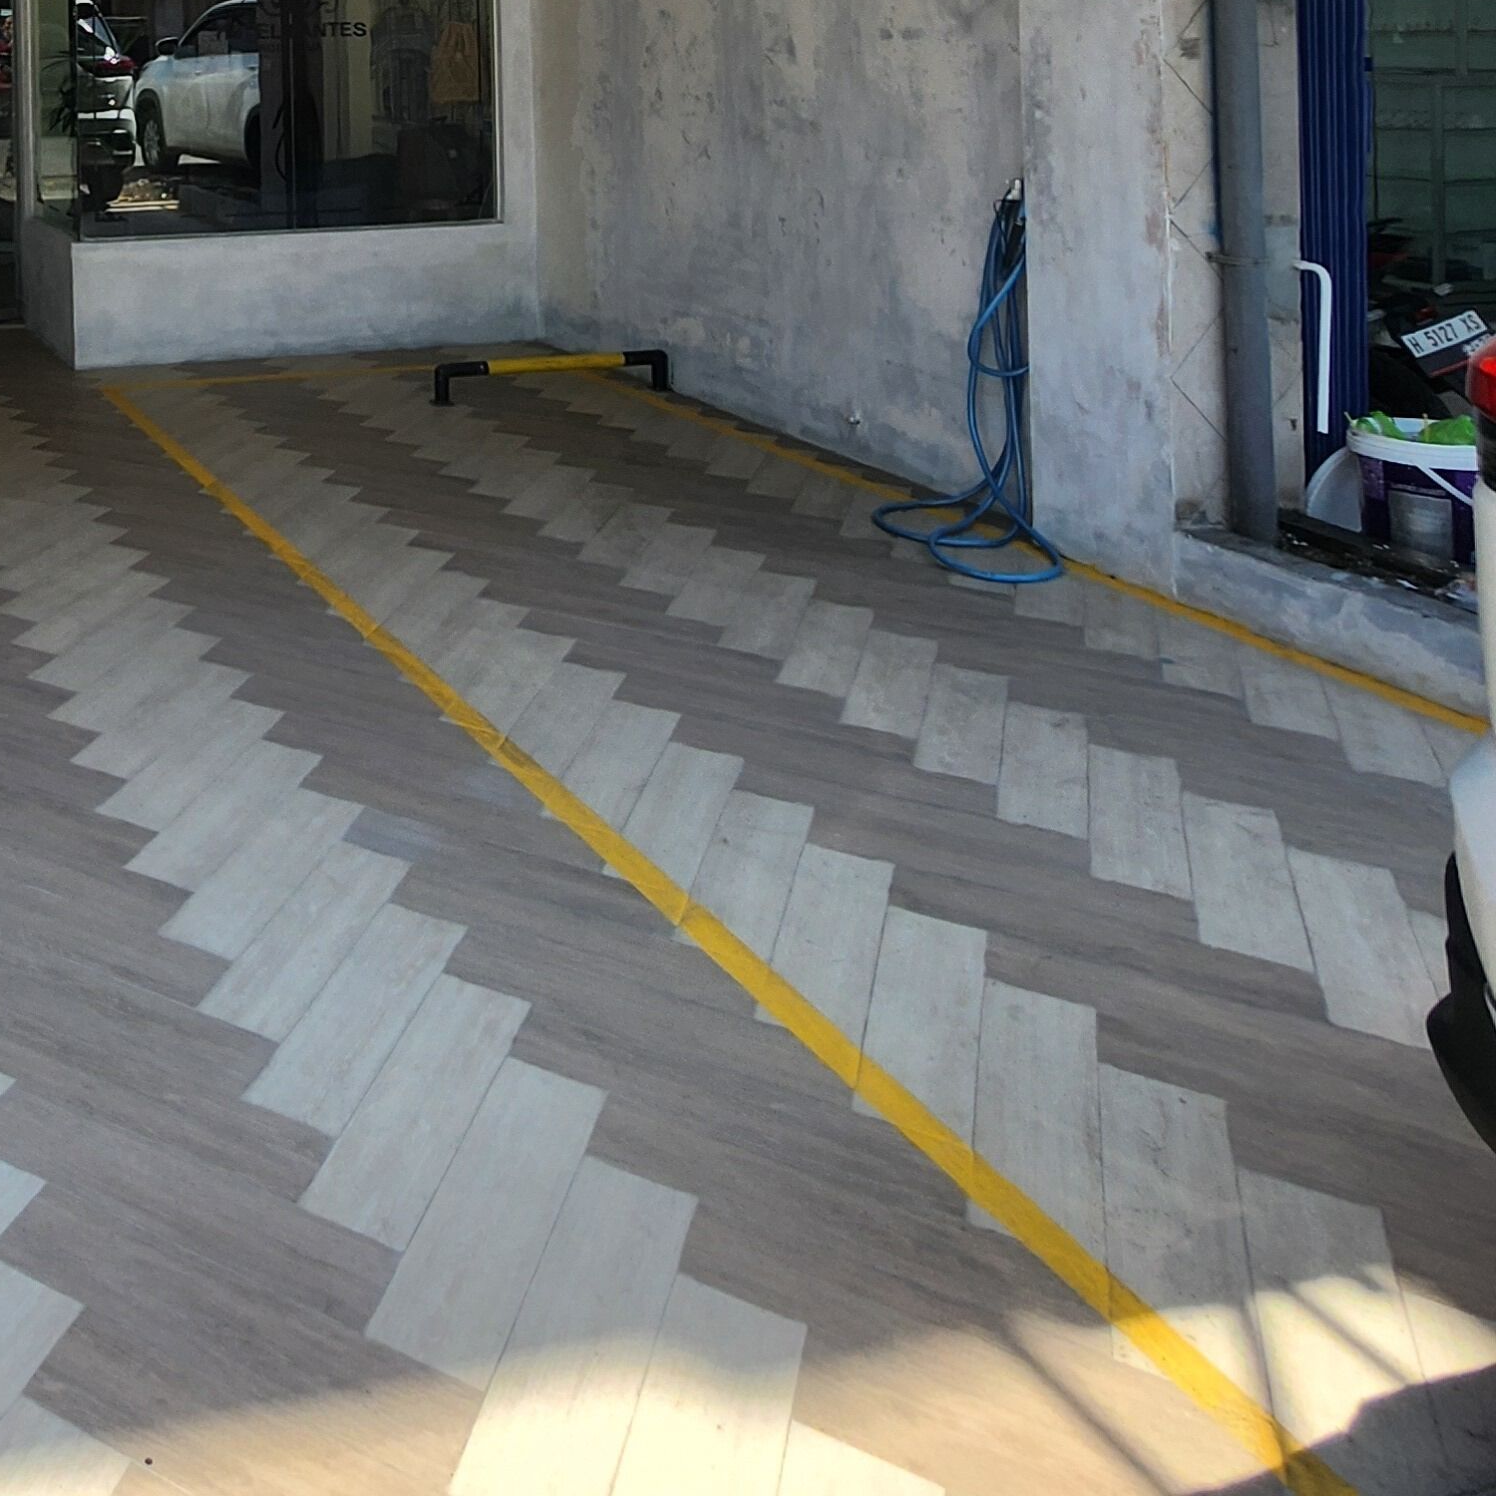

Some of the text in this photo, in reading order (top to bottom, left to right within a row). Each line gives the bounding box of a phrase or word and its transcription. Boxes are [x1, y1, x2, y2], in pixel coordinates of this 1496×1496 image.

[1407, 336, 1425, 354] H
[1424, 322, 1459, 347] 5127
[1458, 313, 1482, 332] XS
